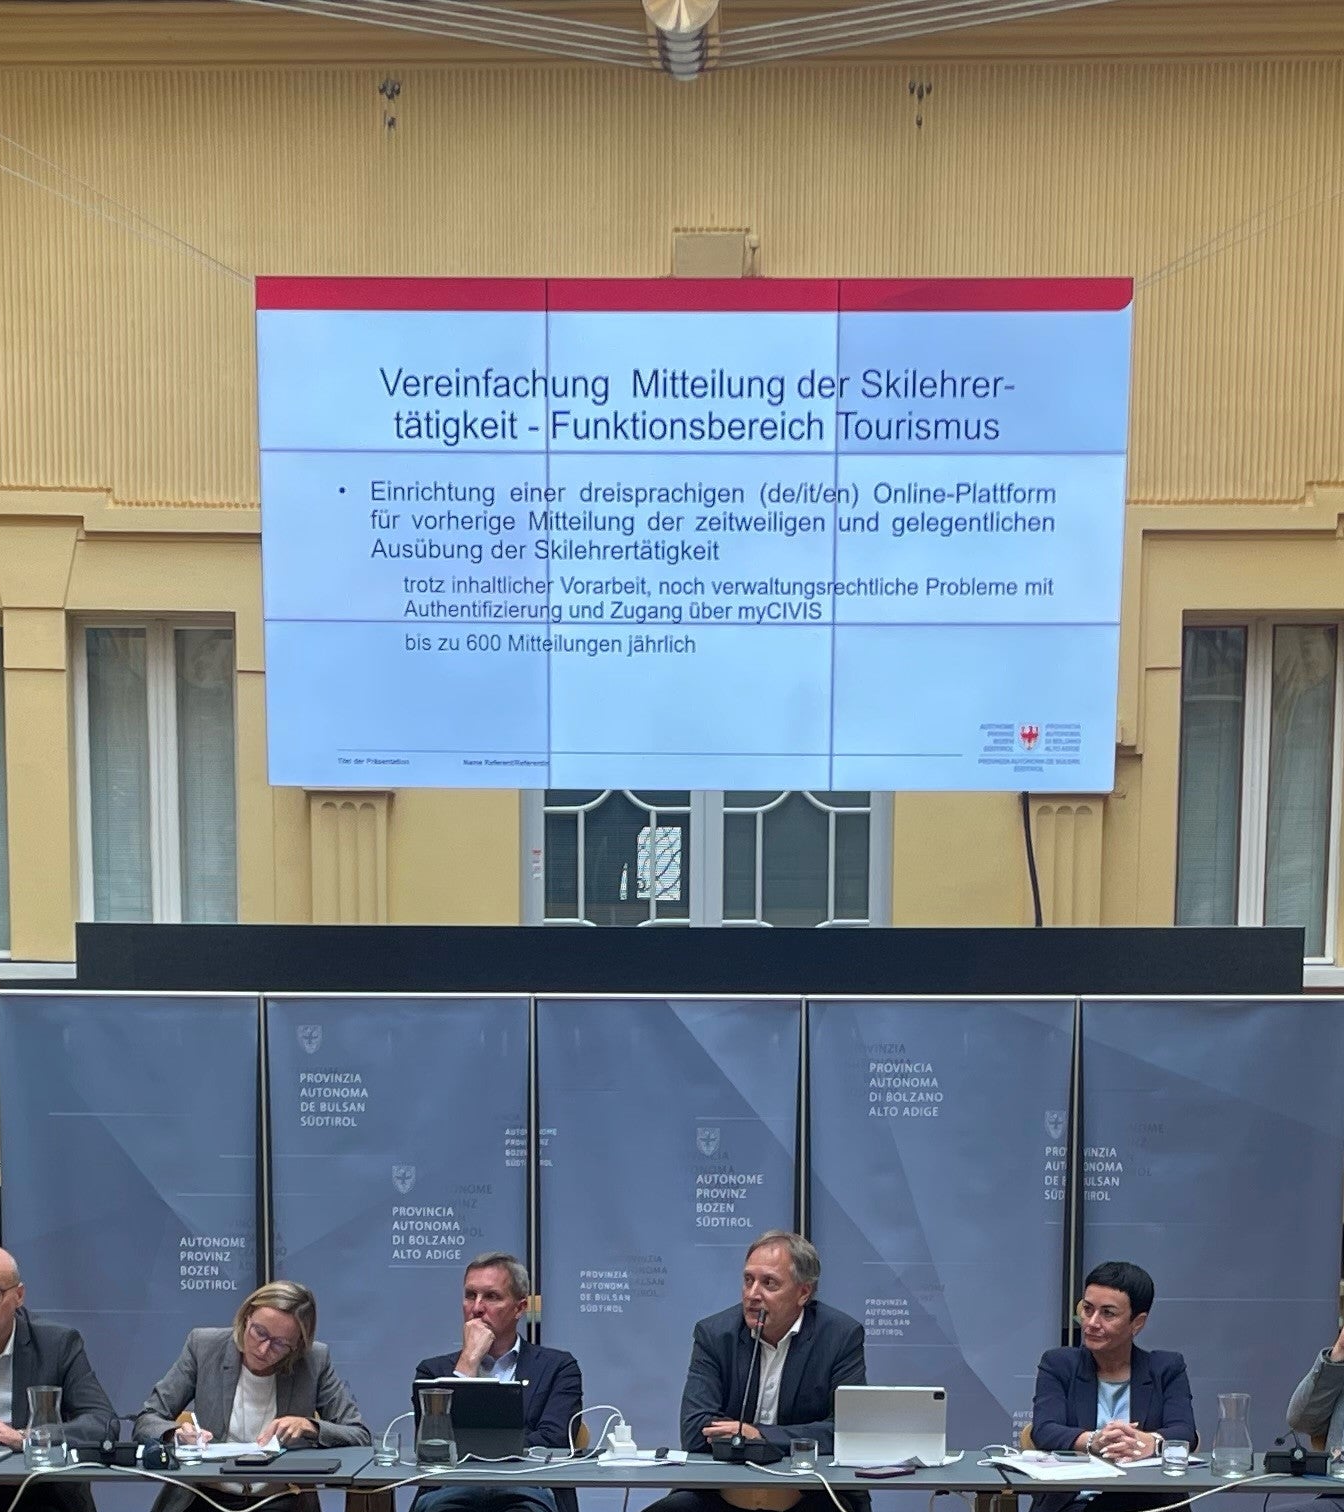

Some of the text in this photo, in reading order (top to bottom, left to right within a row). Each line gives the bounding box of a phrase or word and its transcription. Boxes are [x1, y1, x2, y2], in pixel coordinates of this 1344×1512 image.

[379, 367, 1016, 406] Vereinfachung Mitteilung der Skilehrer-
[394, 409, 519, 446] tätigkeit
[551, 410, 824, 440] Funktionsbereich
[836, 410, 1000, 440] Tourismus
[371, 480, 1057, 509] Einrichtung einer dreisprachigen (de/it/en) Online-Plattform
[370, 509, 1056, 537] für vorherige Mitteilung der zeitweiligen und gelegentlichen
[370, 538, 719, 565] Ausübung der Skilehrertätigkeit
[404, 576, 1055, 599] trotz inhaltlicher Vorarbeit, noch verwaltungsrechtliche Probleme mit
[403, 601, 822, 625] Authentifizierung und Zugang über myCIVIS
[405, 633, 697, 657] bis zu 600 Mitteilungen jährlich
[869, 1062, 933, 1073] PROVINCIA
[299, 1072, 362, 1084] PROVINZIA
[869, 1077, 939, 1088] AUTONOMA
[300, 1087, 369, 1098] AUTONOMA
[869, 1091, 944, 1102] DI BOLZANO
[300, 1101, 366, 1112] DE BULSAN
[868, 1105, 939, 1117] ALTO ADIGE
[300, 1115, 358, 1127] SÜDTIROL
[695, 1174, 765, 1185] AUTONOME
[1044, 1175, 1059, 1186] DE
[696, 1188, 747, 1199] PROVINZ
[392, 1206, 455, 1217] PROVINCIA
[696, 1202, 735, 1213] BOZEN
[392, 1220, 461, 1231] AUTONOMA
[695, 1215, 754, 1228] SÜDTIROL
[179, 1236, 247, 1248] AUTONOME
[392, 1235, 466, 1246] DI BOLZANO
[179, 1251, 232, 1262] PROVINZ
[392, 1249, 462, 1260] ALTO ADIGE
[180, 1265, 220, 1276] BOZEN
[179, 1278, 238, 1291] SÜDTIROL
